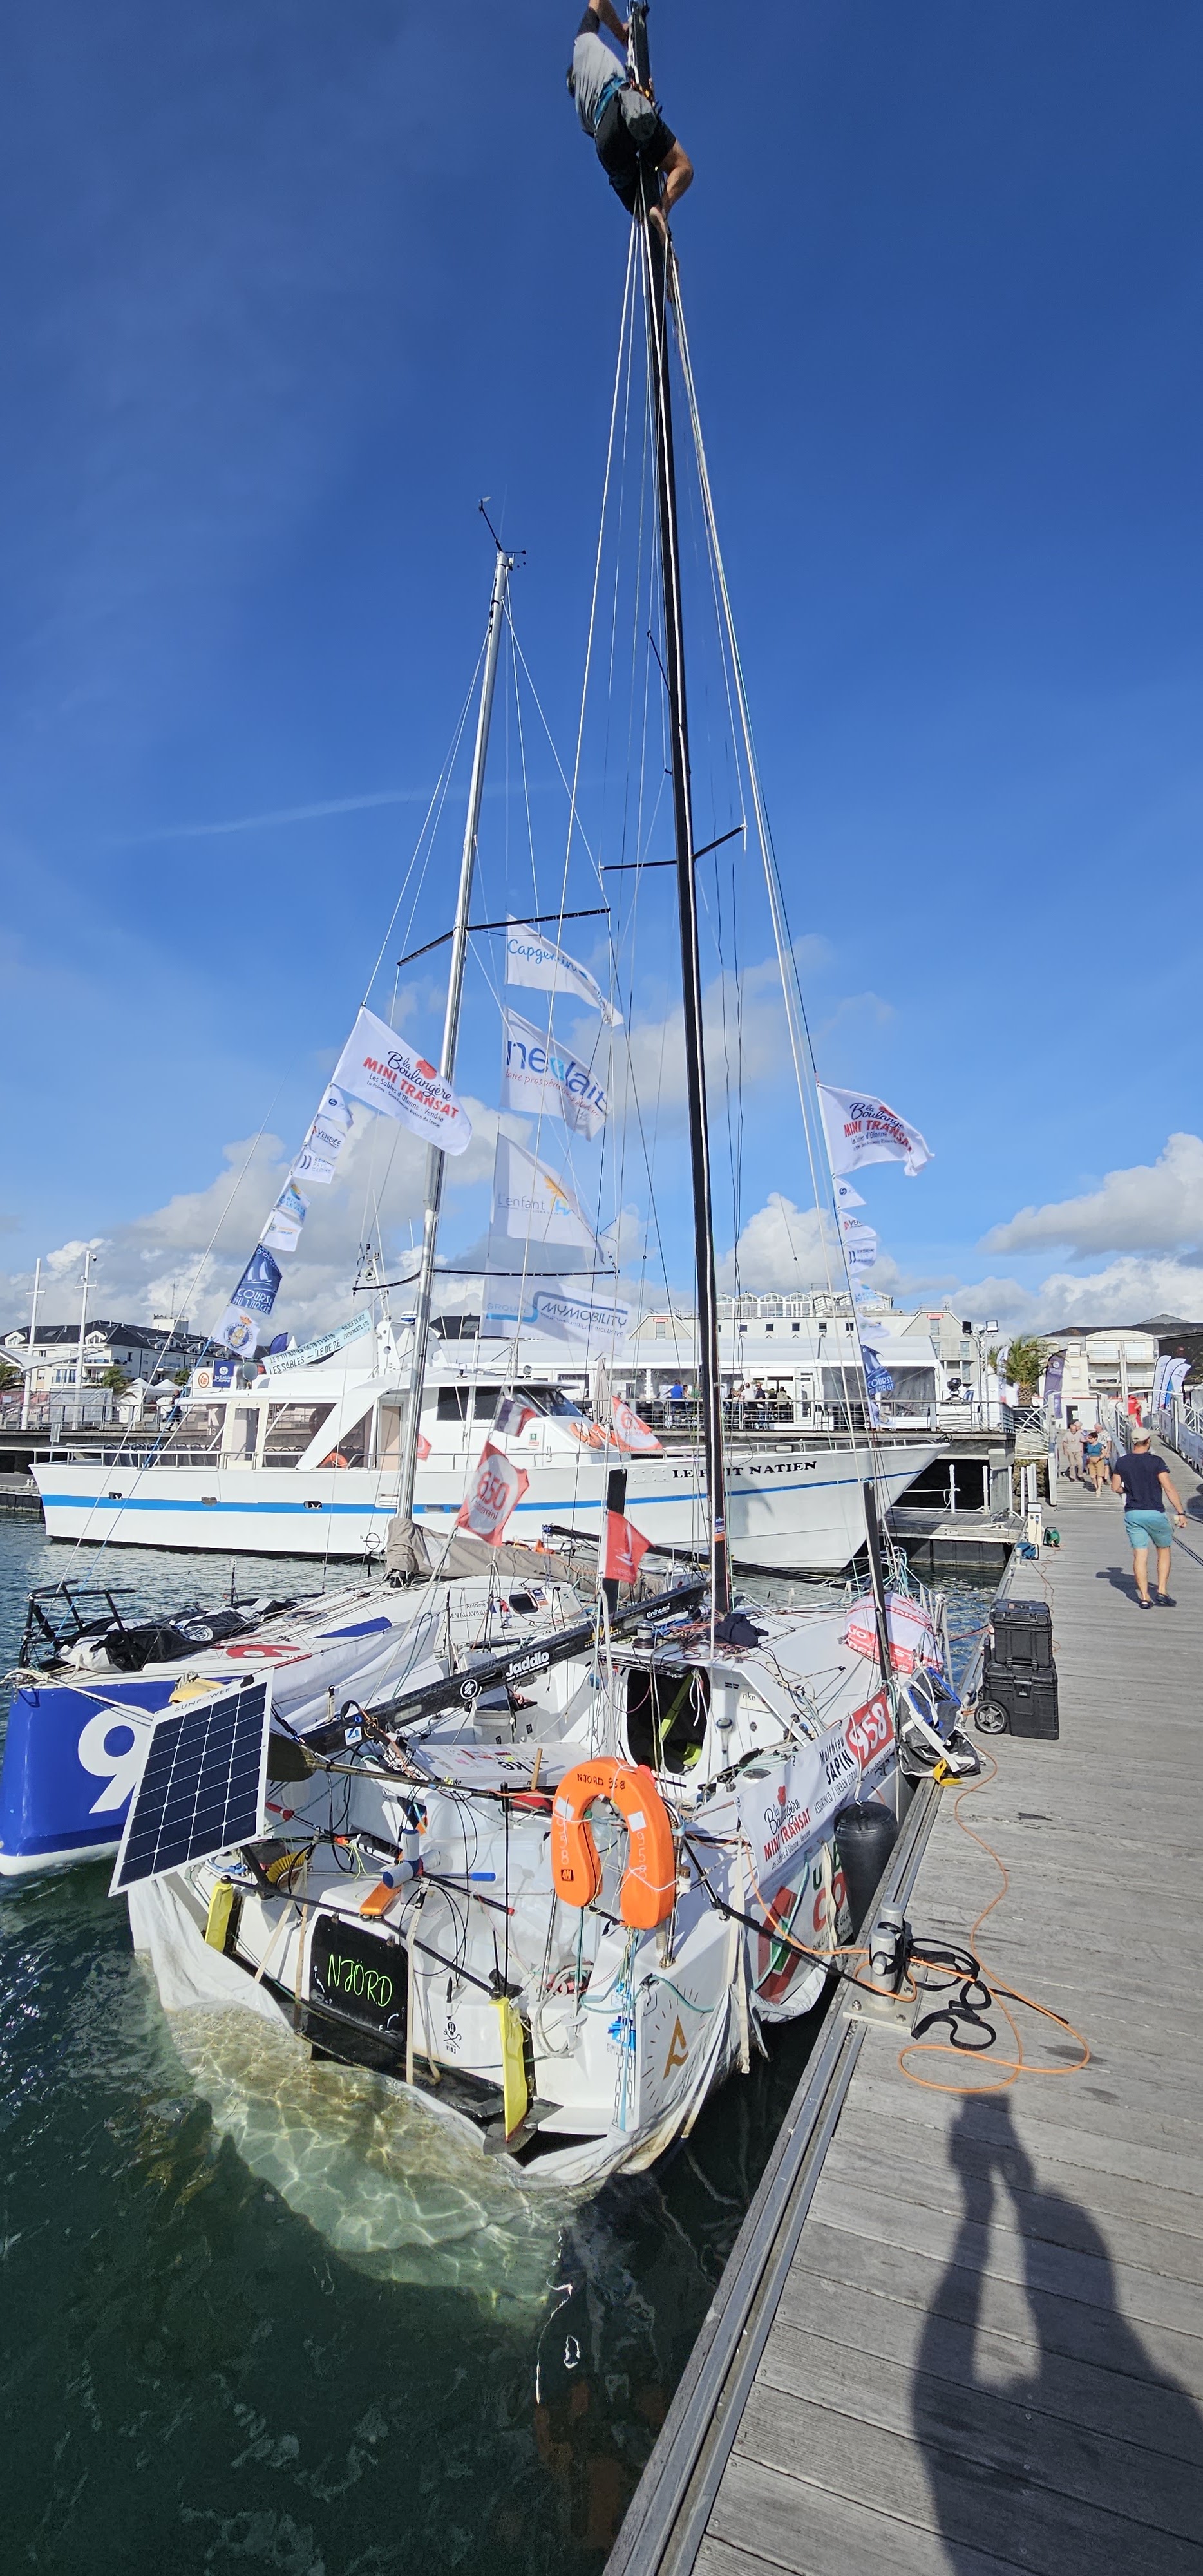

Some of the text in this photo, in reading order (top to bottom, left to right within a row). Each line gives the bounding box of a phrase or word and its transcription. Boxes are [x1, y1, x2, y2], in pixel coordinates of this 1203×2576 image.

[363, 1056, 398, 1084] MINI
[400, 1078, 459, 1119] TRANSAT
[369, 1073, 379, 1083] Les
[381, 1078, 397, 1094] Sables
[388, 1050, 451, 1102] Boulangère
[844, 1120, 862, 1138] MINI
[541, 1302, 627, 1328] MYMOBILITY
[269, 1364, 282, 1375] LES
[281, 1356, 305, 1371] SABLES
[673, 1469, 694, 1478] LE
[750, 1461, 817, 1475] NATIEN
[477, 1471, 509, 1511] 650
[175, 1687, 231, 1712] SUNPOWER
[743, 1692, 756, 1701] nke
[848, 1702, 887, 1759] 958
[819, 1736, 844, 1767] Matthieu
[577, 1773, 604, 1786] NJORD
[826, 1749, 855, 1785] SAPIN
[764, 1807, 811, 1862] MINI TRANSAT
